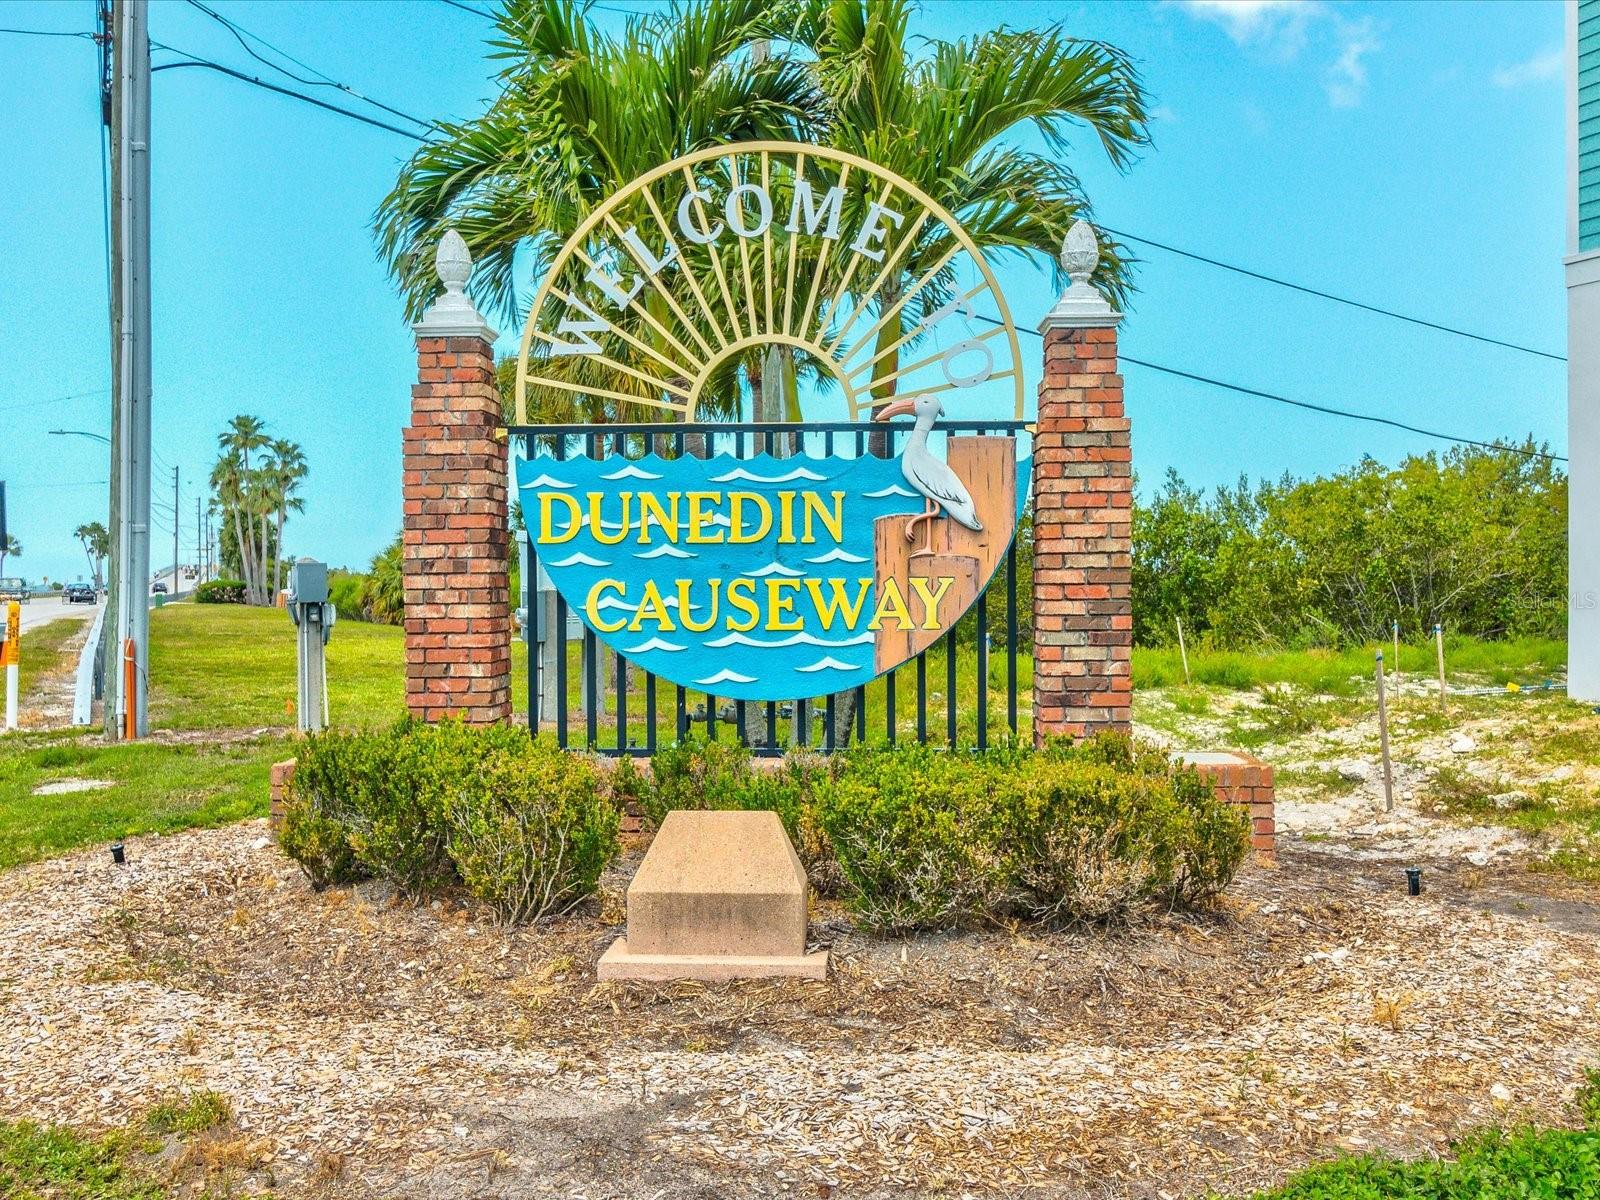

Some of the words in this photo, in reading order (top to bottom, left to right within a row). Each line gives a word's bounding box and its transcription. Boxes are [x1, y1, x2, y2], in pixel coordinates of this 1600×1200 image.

[550, 180, 904, 356] WELCOME
[920, 281, 994, 388] TO
[537, 490, 844, 545] DUNEDIN
[584, 576, 954, 632] CAUSEWAY
